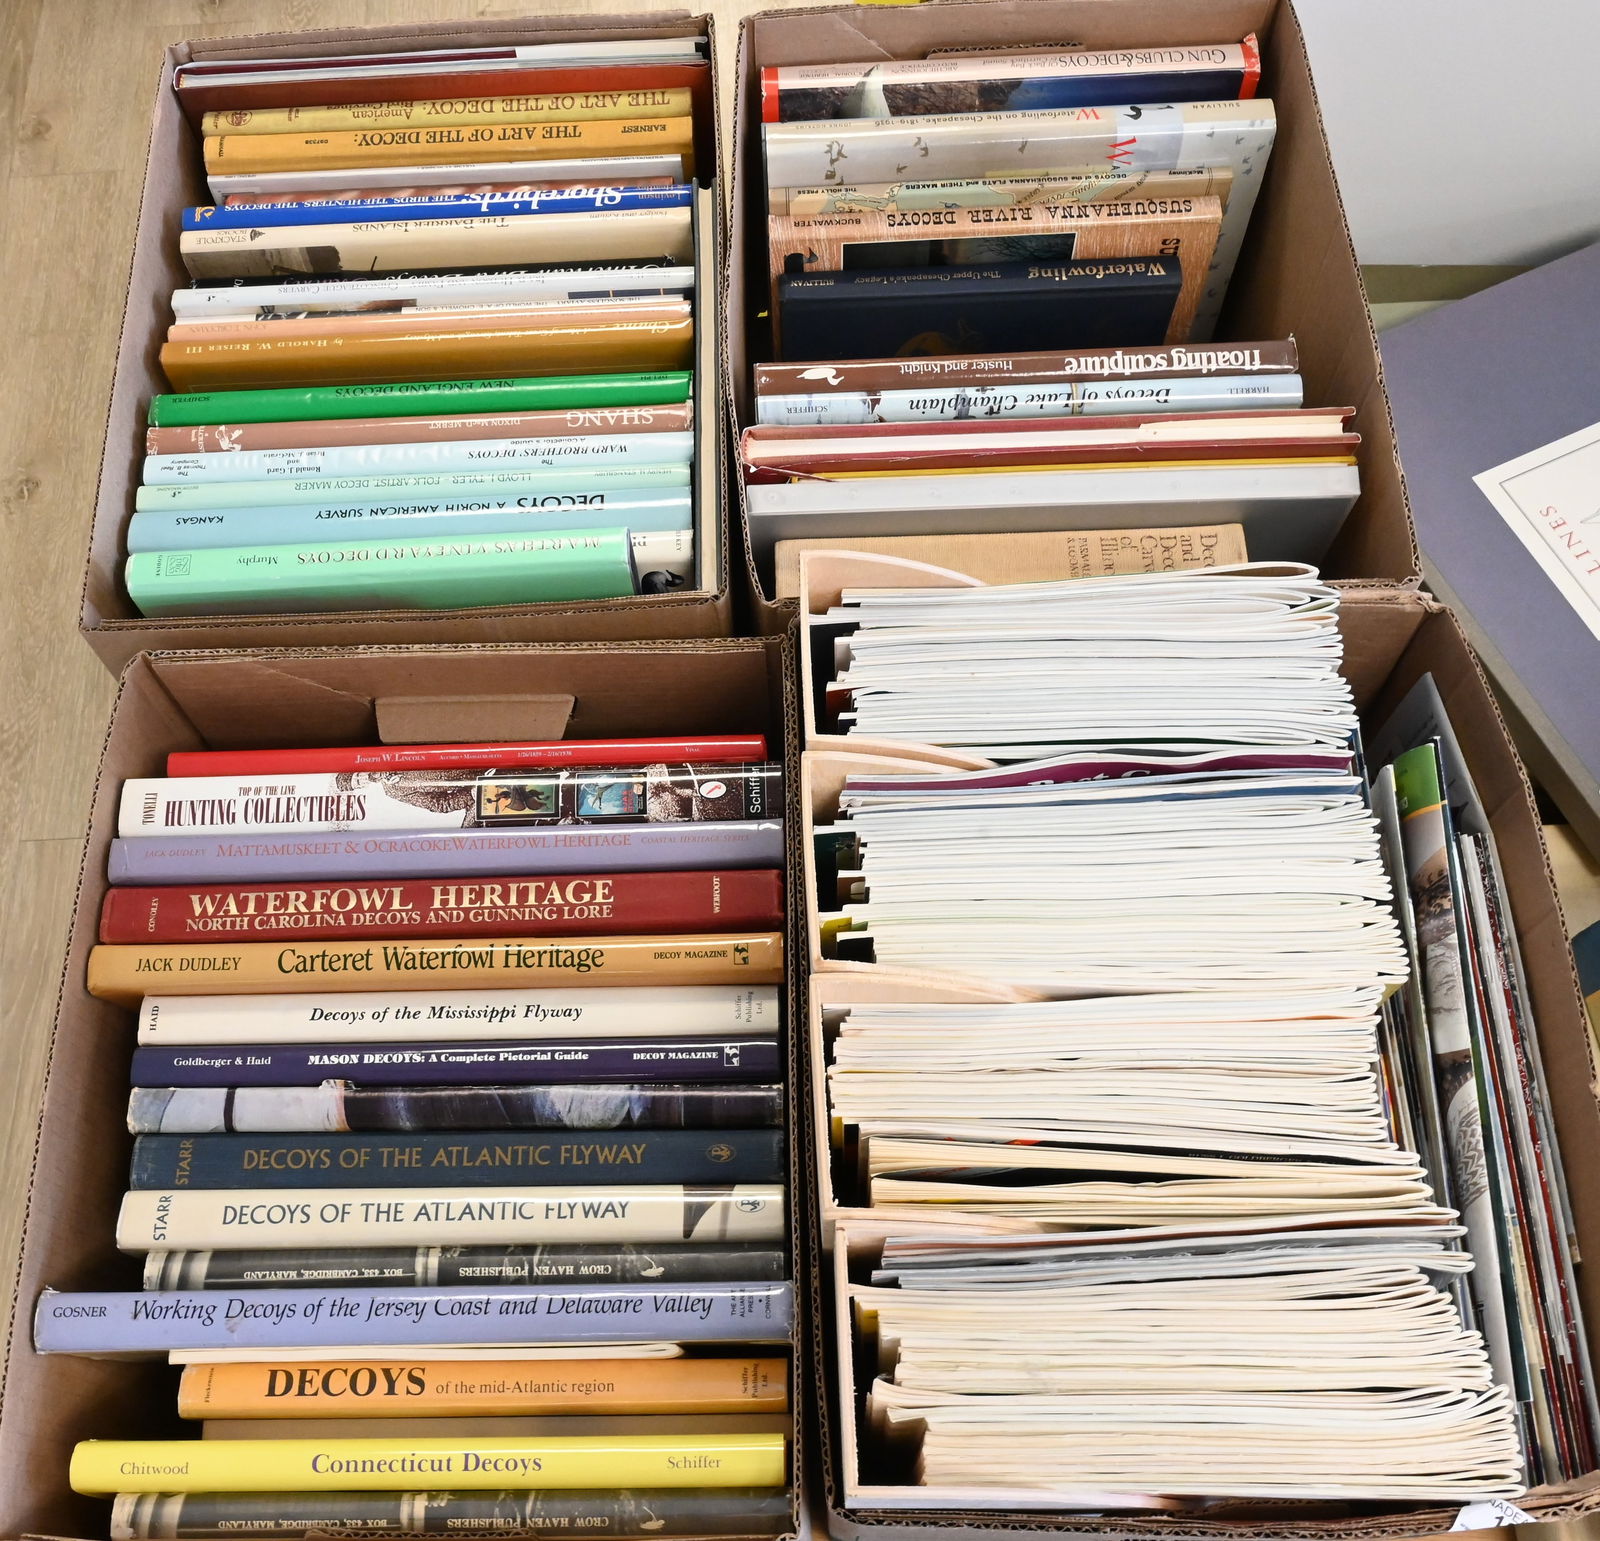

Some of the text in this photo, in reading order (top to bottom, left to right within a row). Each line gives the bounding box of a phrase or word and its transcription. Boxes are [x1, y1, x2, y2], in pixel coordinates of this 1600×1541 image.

[1188, 50, 1225, 65] GUN
[423, 92, 670, 114] THE ART OF THE DECOY:
[352, 108, 413, 120] American
[354, 125, 582, 145] THE ART OF THE DECOY:
[622, 124, 666, 133] EARNEST
[886, 200, 1192, 226] SUSQUEHANNA RIVER DECOYS
[352, 222, 408, 232] ISLANDS
[794, 218, 861, 227] BUCKWALTER
[196, 236, 247, 244] STACKPOLE
[890, 274, 950, 283] Chesapeake's
[1028, 262, 1166, 280] Waterfowling
[900, 360, 1012, 374] Huster and Knight
[1064, 348, 1260, 376] floating sculpture
[909, 388, 1170, 414] Decoys of Lake Champlain
[567, 408, 653, 427] SHANG
[787, 406, 828, 414] SCHIFFER
[468, 450, 517, 459] DECOYS
[591, 444, 627, 453] WARD
[370, 505, 439, 517] AMERICAN
[446, 503, 490, 512] NORTH
[517, 494, 604, 512] DECOYS
[176, 516, 224, 525] KANGAS
[315, 508, 362, 519] SURVEY
[1540, 505, 1600, 575] LINES
[297, 550, 368, 564] DECOYS
[376, 543, 488, 559] VINEYARD
[236, 556, 278, 566] Murphy
[355, 753, 425, 764] JOSEPH W. LINCOLN
[238, 785, 296, 796] TOP OF THE LINE
[750, 766, 760, 813] Schiffer
[164, 794, 366, 827] HUNTING COLLECTIBLES
[144, 848, 206, 858] JACK DUDLEY
[216, 840, 340, 858] MATTAMUSKEET
[345, 841, 358, 854] &
[554, 834, 632, 848] HERITAGE
[189, 880, 614, 916] WATERFOWL HERITAGE
[148, 897, 159, 932] CONOLEY
[186, 904, 612, 932] NORTH CAROLINA DECOYS AND GUNNING LORE
[278, 944, 604, 974] Carteret Waterfowl Heritage
[654, 950, 727, 960] DECOY MAGAZINE
[136, 956, 241, 972] JACK DUDLEY
[150, 1005, 159, 1031] HAID
[310, 1004, 582, 1024] Decoys of the Mississippi Flyway
[174, 1056, 270, 1068] Goldberger & Haid
[308, 1052, 588, 1065] MASON DECOYS: A Complete Pictorial Guide
[668, 1052, 718, 1060] MAGAZINE
[176, 1139, 194, 1185] STARR
[243, 1144, 646, 1169] DECOYS OF THE ATLANTIC FLYWAY
[154, 1194, 173, 1240] STARR
[222, 1201, 628, 1224] DECOYS OF THE ATLANTIC FLYWAY
[53, 1306, 106, 1318] GOSNER
[133, 1295, 713, 1325] Working Decoys of the Jersey Coast and Delaware Valley
[264, 1367, 426, 1398] DECOYS
[436, 1380, 615, 1396] of the mid-Atlantic region
[120, 1462, 189, 1476] Chitwood
[312, 1452, 542, 1476] Connecticut Decoys
[666, 1456, 721, 1469] Schiffer
